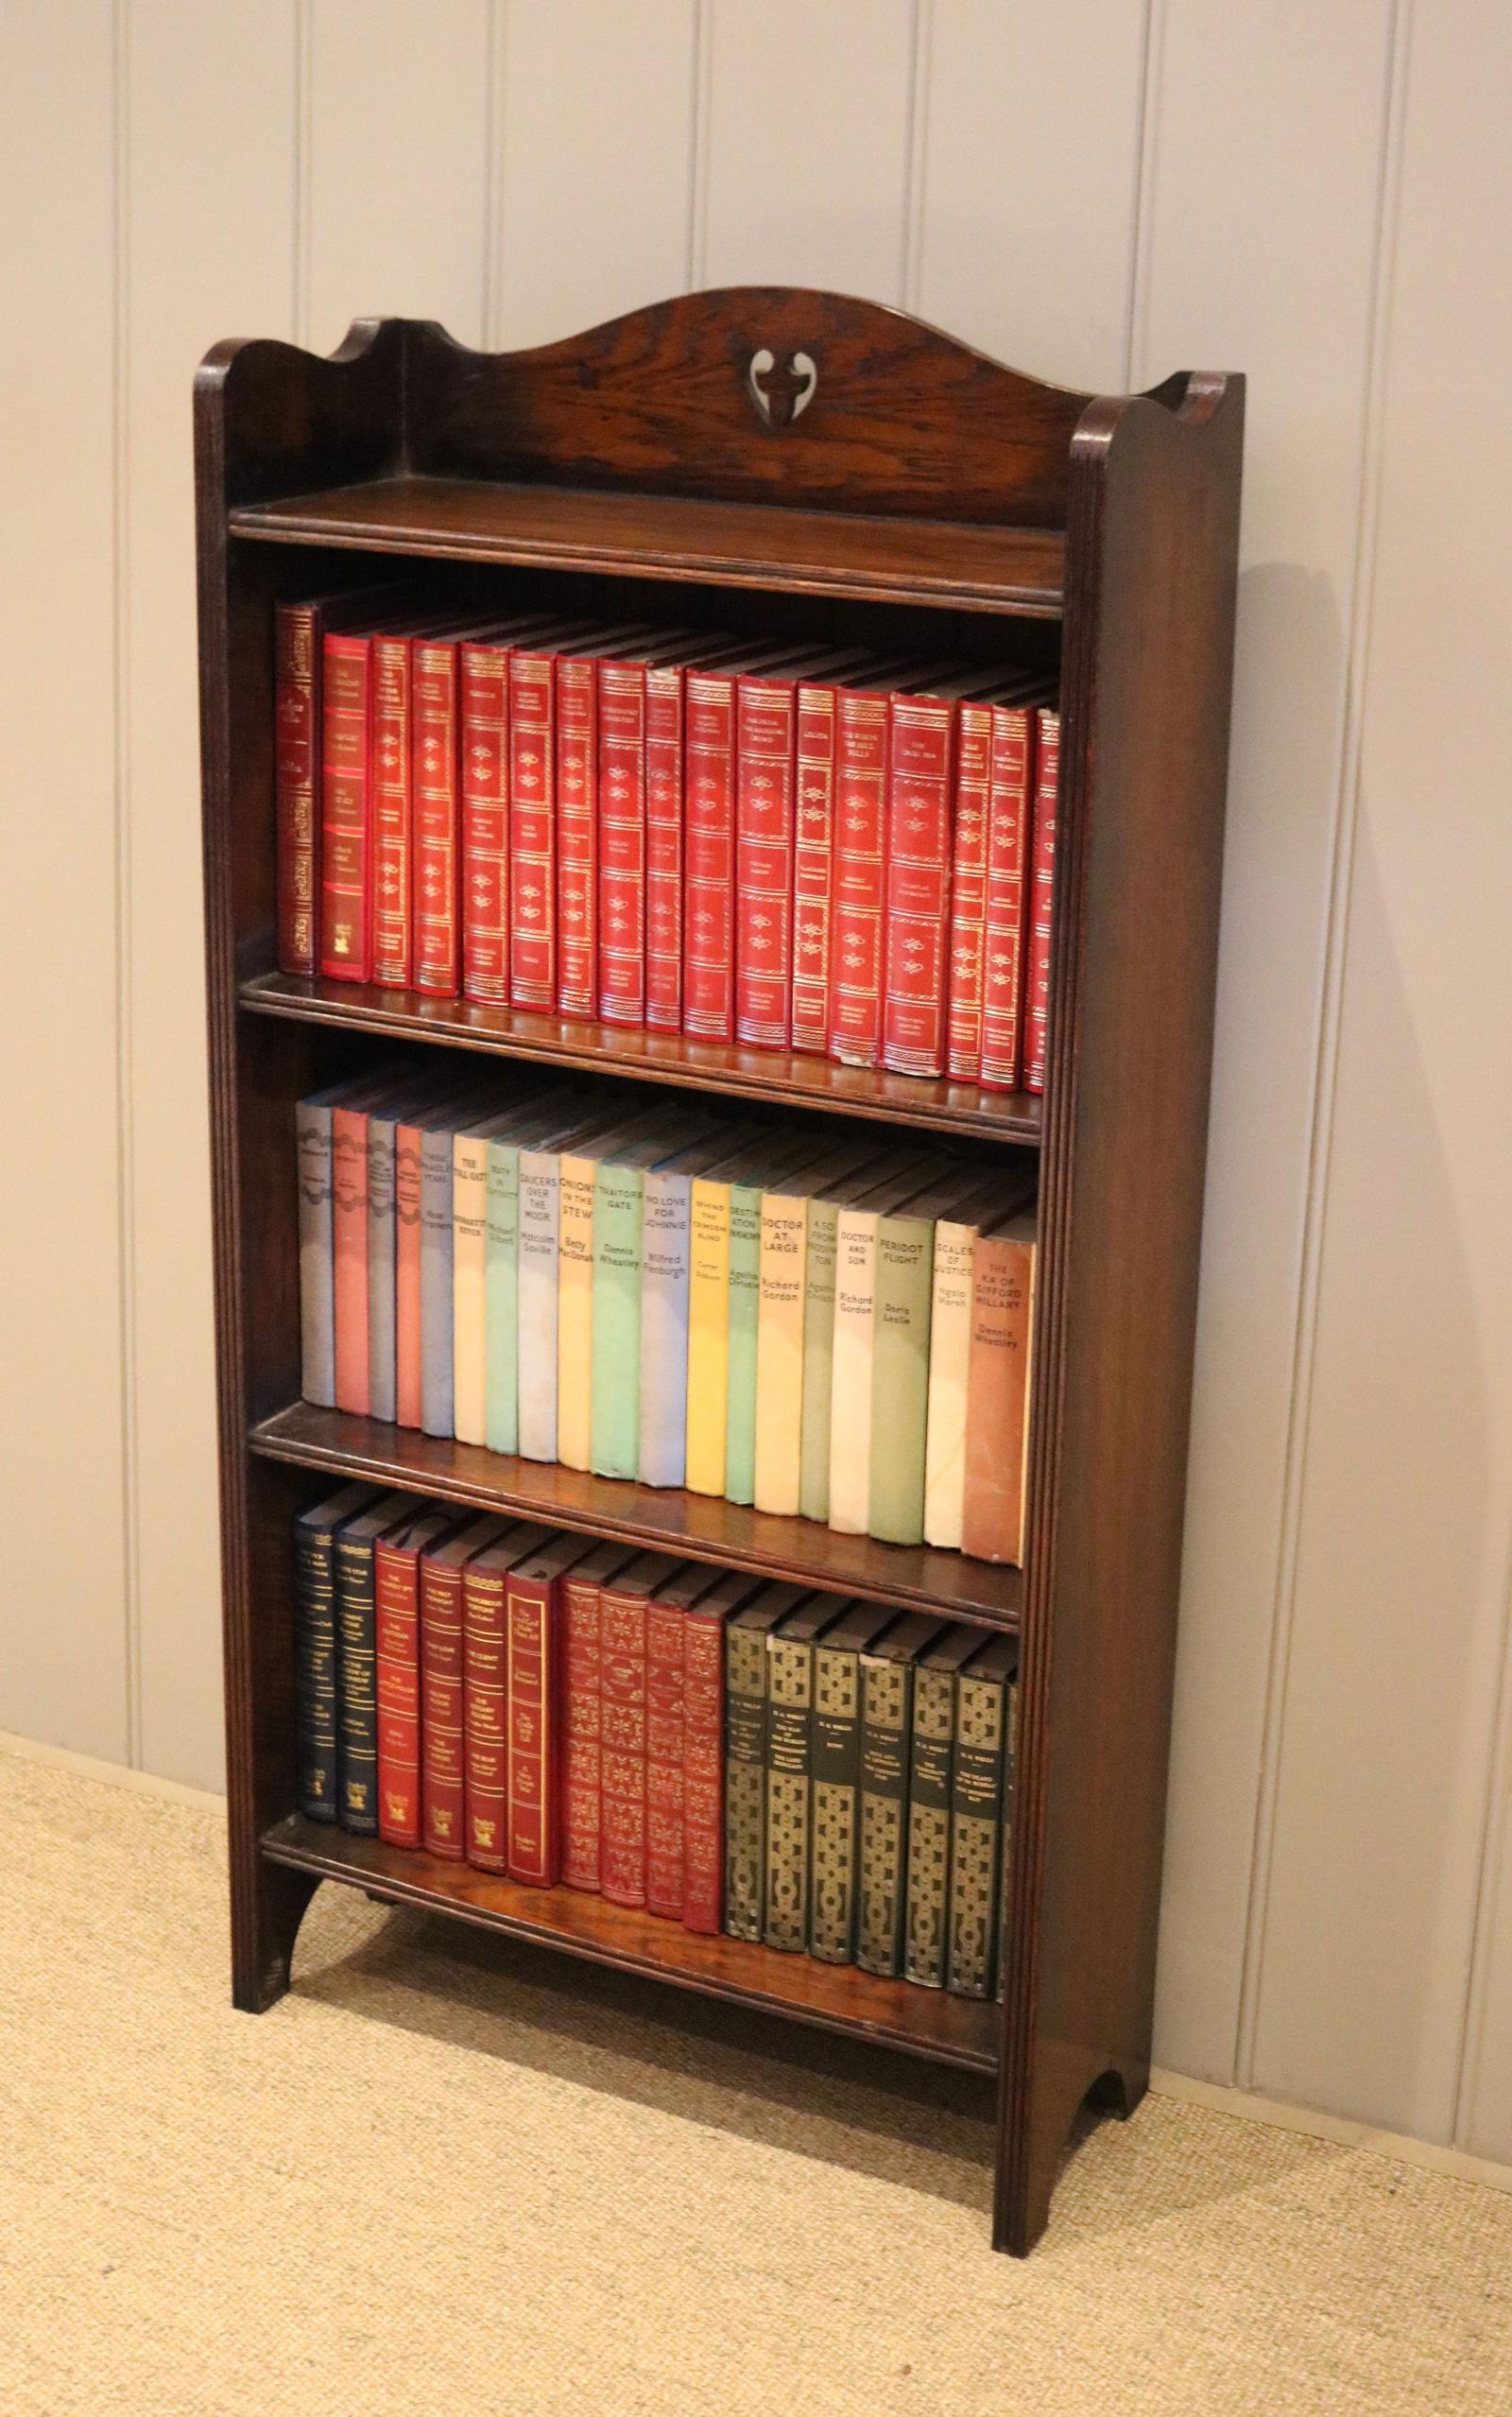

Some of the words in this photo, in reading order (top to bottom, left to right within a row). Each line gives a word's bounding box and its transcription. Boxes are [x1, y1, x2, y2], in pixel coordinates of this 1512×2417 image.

[520, 1173, 557, 1187] SAUCERS
[526, 1187, 548, 1198] OVER
[562, 1192, 572, 1200] IN
[574, 1195, 593, 1205] THE
[598, 1185, 644, 1200] TRAITORS
[529, 1199, 546, 1210] THE
[608, 1200, 632, 1210] GATE
[645, 1195, 659, 1205] NO
[661, 1196, 686, 1206] LOVE
[696, 1200, 725, 1212] BEHIND
[524, 1211, 550, 1221] MOOR
[562, 1205, 593, 1218] STEW
[654, 1209, 675, 1217] FOR
[701, 1212, 717, 1220] THE
[645, 1218, 686, 1230] JOHNNIE
[692, 1220, 728, 1233] CRIMSON
[762, 1217, 803, 1230] DOCTOR
[520, 1232, 555, 1244] Malcolm
[697, 1233, 721, 1242] BLIND
[774, 1232, 788, 1241] AT
[840, 1231, 874, 1243] DOCTOR
[524, 1243, 552, 1255] Saville
[565, 1236, 586, 1252] Betty
[604, 1243, 634, 1255] Dennis
[764, 1241, 799, 1253] LARGE
[849, 1245, 866, 1253] AND
[879, 1238, 923, 1253] PERIDOT
[936, 1243, 973, 1255] SCALES
[599, 1254, 640, 1270] Wheatley
[648, 1252, 680, 1264] Wilfred
[815, 1255, 832, 1266] TON
[848, 1255, 866, 1265] SON
[883, 1252, 919, 1266] FLIGHT
[947, 1256, 959, 1265] OF
[935, 1267, 973, 1277] JUSTICE
[989, 1264, 1007, 1274] THE
[762, 1278, 800, 1290] Richard
[982, 1275, 995, 1284] KA
[1002, 1277, 1015, 1286] OF
[763, 1290, 798, 1302] Gordon
[975, 1284, 1022, 1299] GIFFORD
[839, 1292, 872, 1304] Richard
[975, 1297, 1021, 1309] HILLARY
[839, 1303, 872, 1315] Gordon
[885, 1303, 910, 1315] Doris
[883, 1313, 911, 1325] Leslie
[979, 1323, 1013, 1338] Dennis
[975, 1334, 1018, 1350] Wheatley
